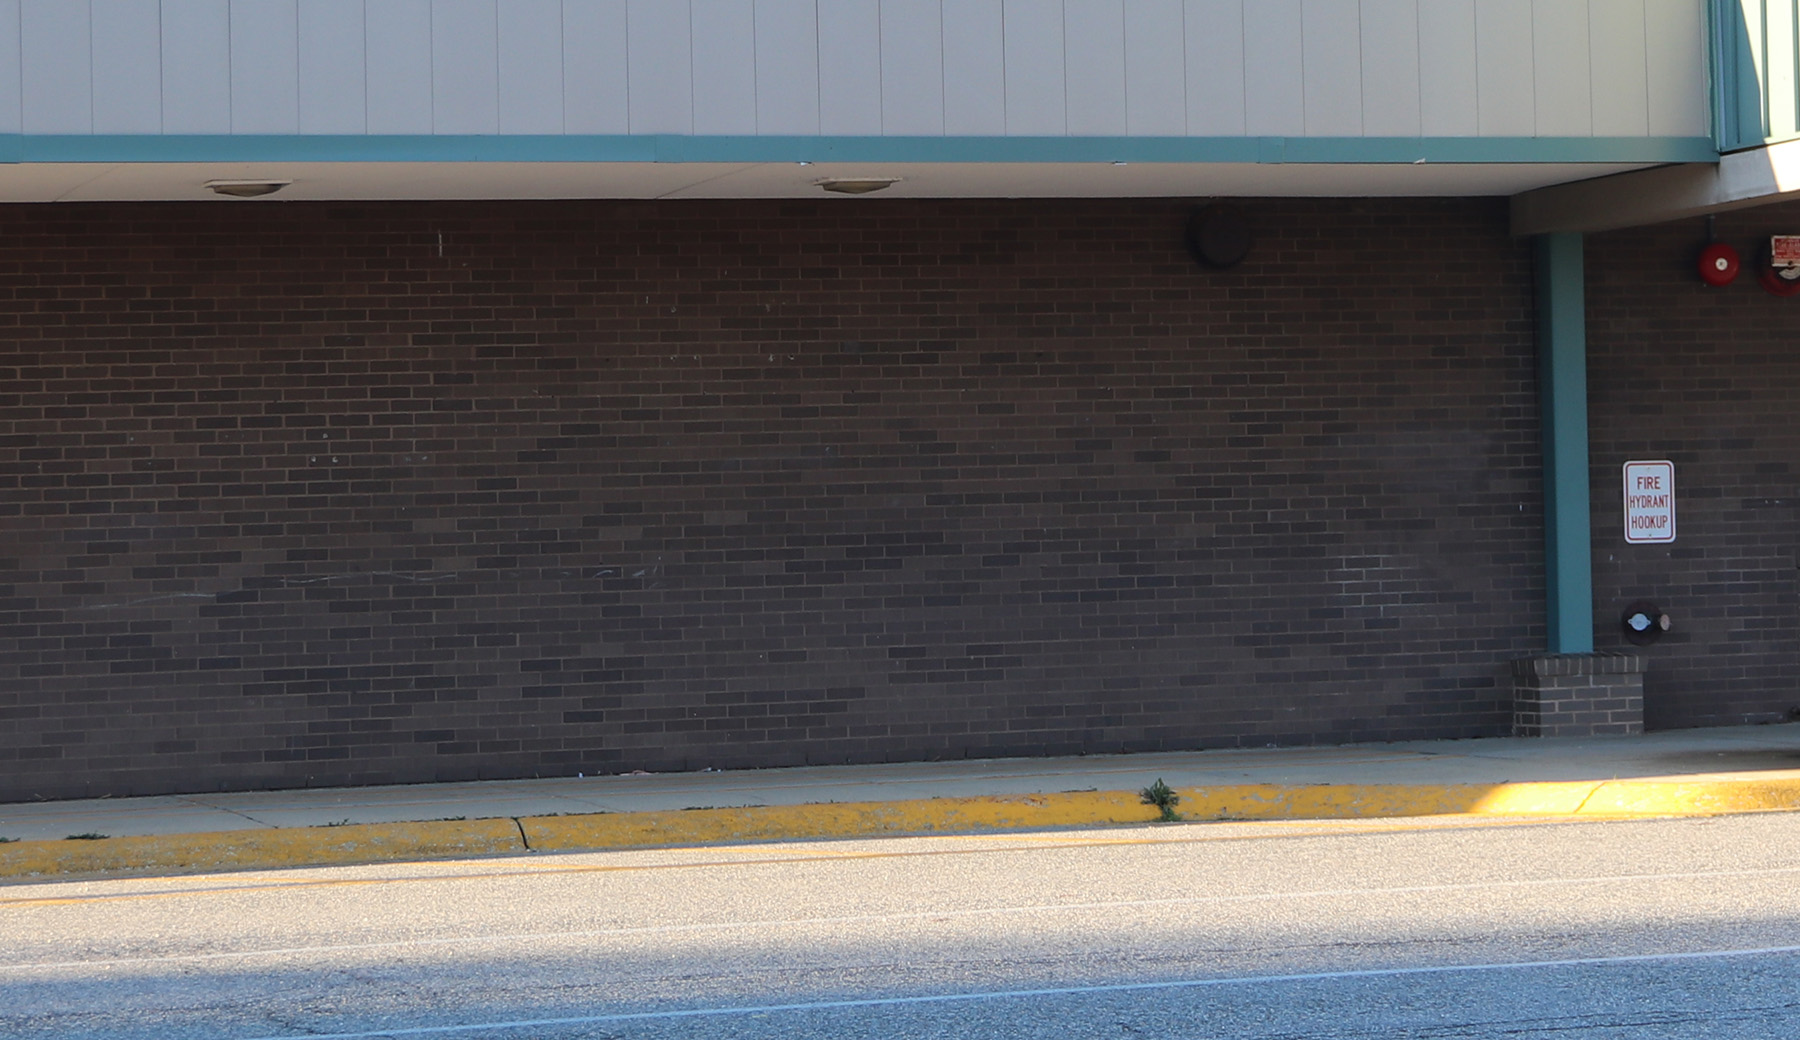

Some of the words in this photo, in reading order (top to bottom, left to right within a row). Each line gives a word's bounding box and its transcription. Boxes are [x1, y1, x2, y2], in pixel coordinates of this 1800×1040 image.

[1636, 476, 1661, 490] FIRE
[1629, 494, 1669, 509] HYDRANT
[1631, 515, 1668, 529] HOOKUP
